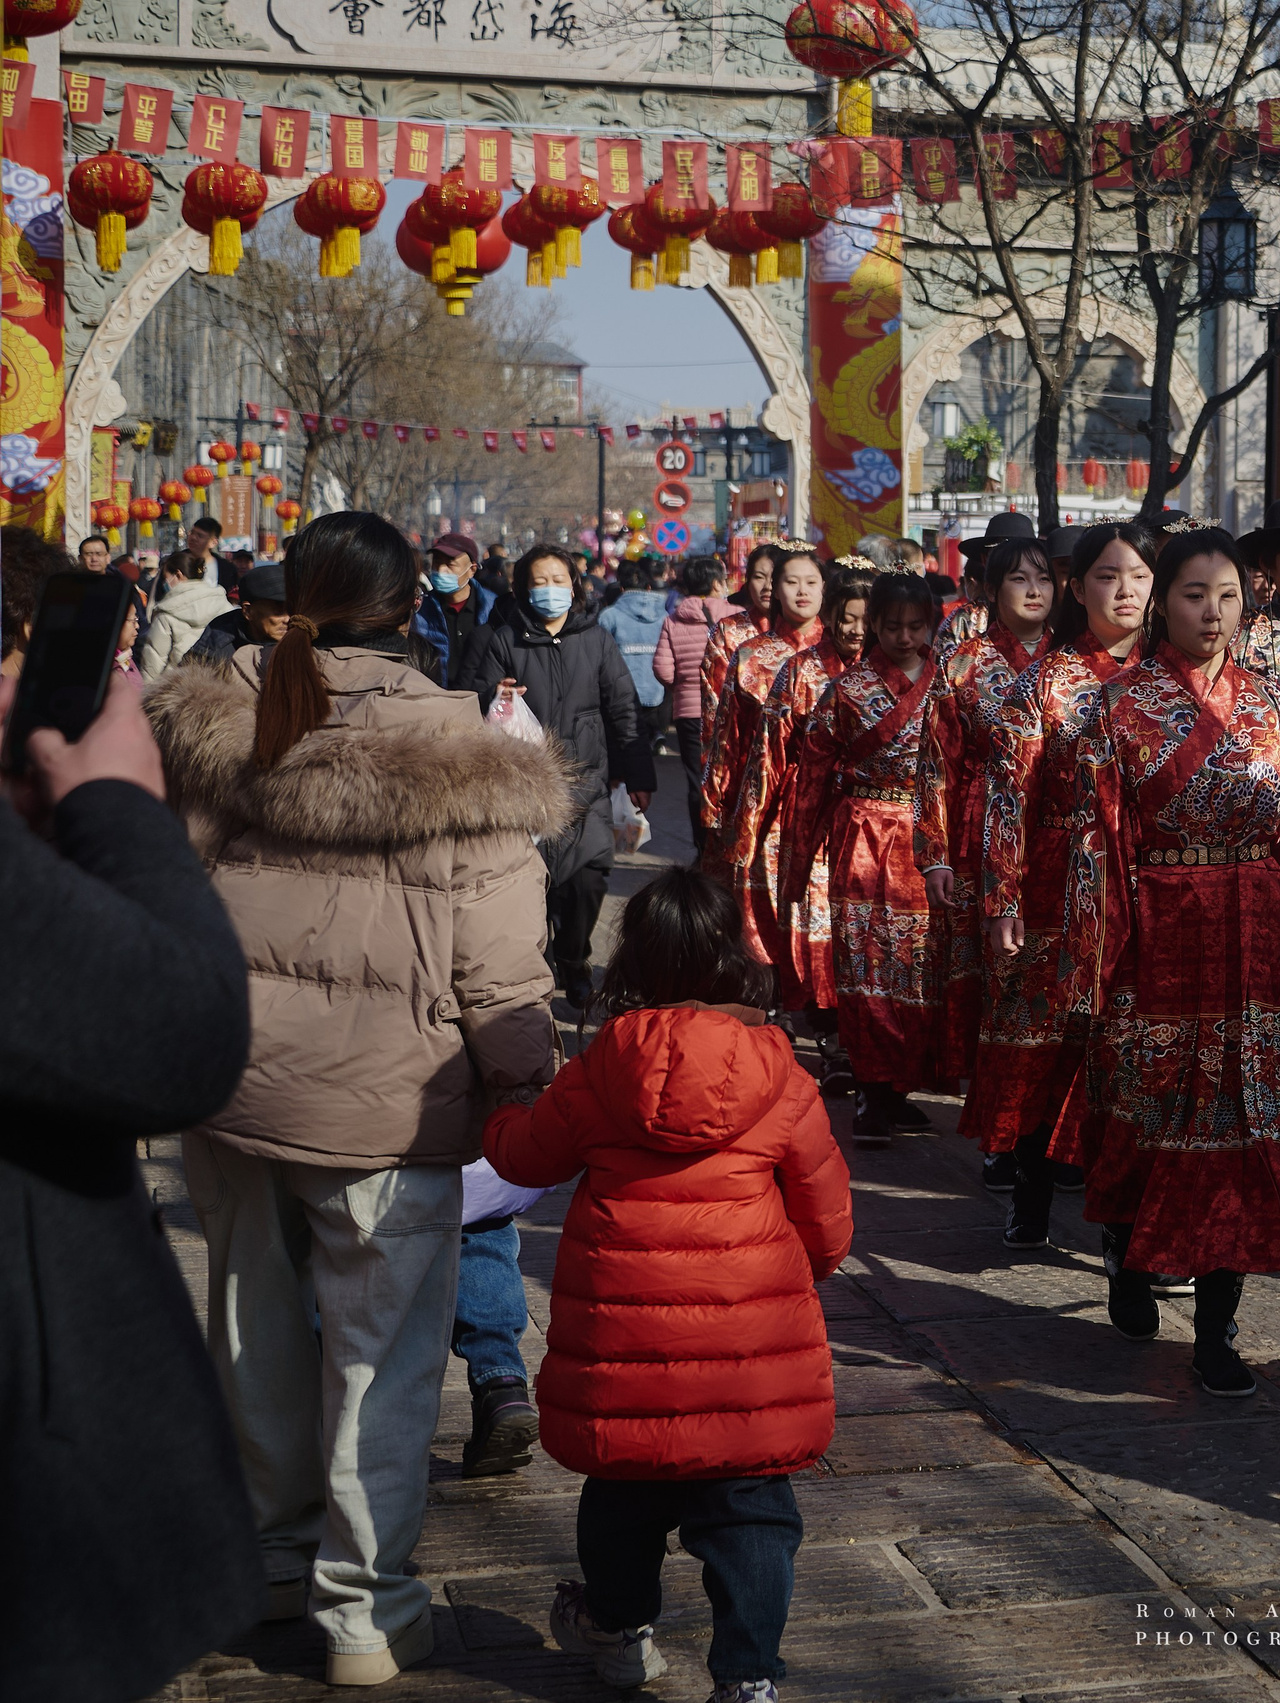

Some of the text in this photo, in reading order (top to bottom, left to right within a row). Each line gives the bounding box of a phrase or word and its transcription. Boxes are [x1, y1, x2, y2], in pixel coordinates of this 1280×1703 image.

[69, 72, 90, 113] 自由
[133, 94, 158, 143] 平等
[204, 104, 227, 152] 公正
[272, 116, 295, 168] 法治
[344, 118, 365, 168] 爱国
[409, 129, 429, 174] 敬业
[478, 137, 498, 182] 诚信
[547, 141, 566, 181] 友善
[610, 147, 630, 194] 富强
[675, 150, 694, 199] 民主
[739, 152, 759, 201] 文明
[861, 151, 881, 198] 自由
[662, 448, 686, 470] 20
